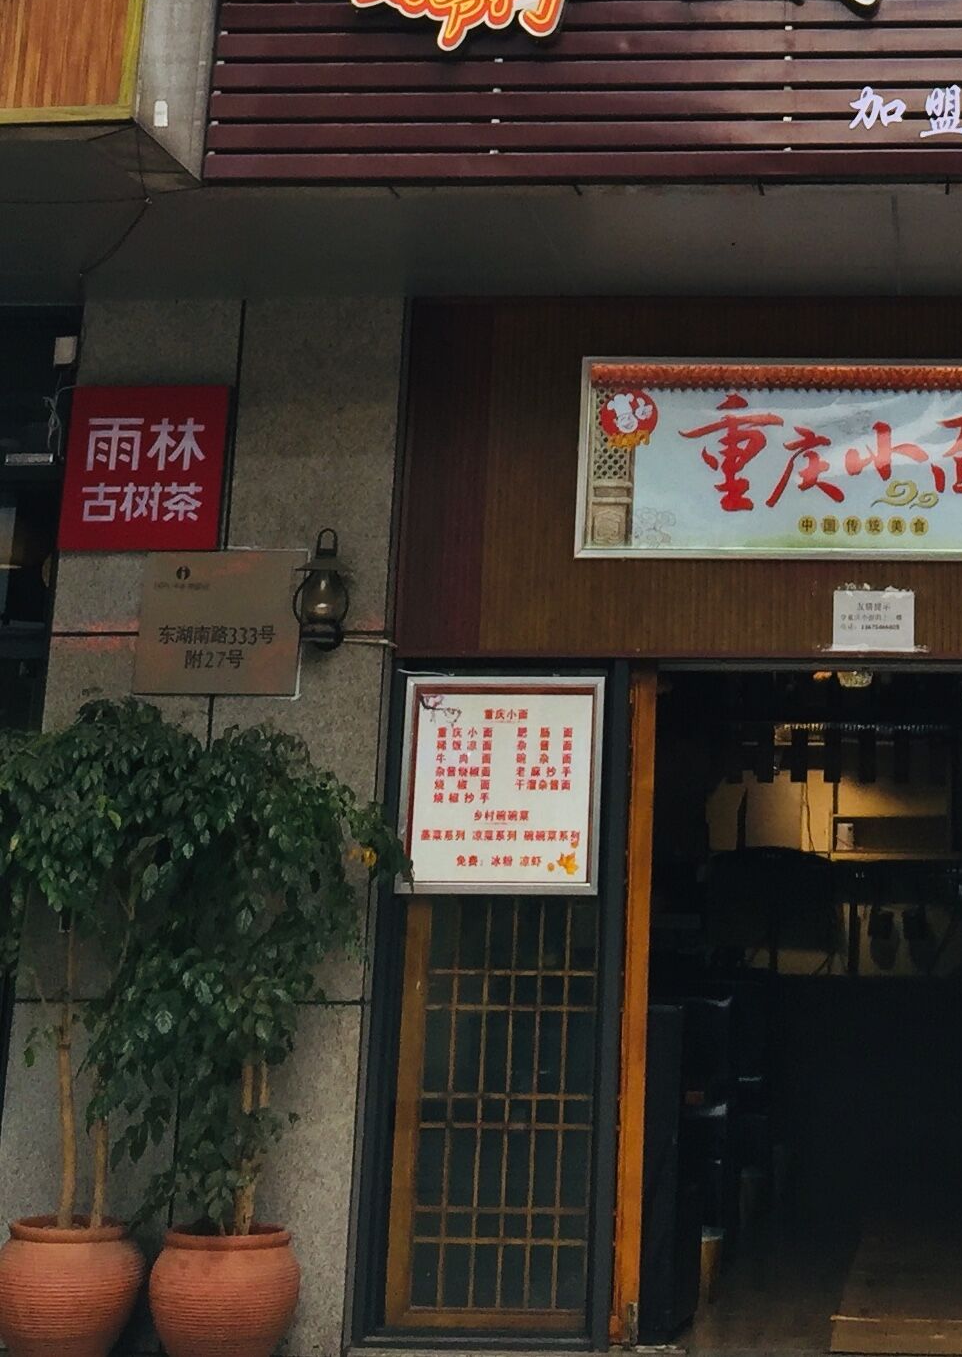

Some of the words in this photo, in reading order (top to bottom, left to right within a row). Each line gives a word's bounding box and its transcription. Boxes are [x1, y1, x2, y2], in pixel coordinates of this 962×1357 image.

[86, 417, 206, 472] 雨林
[82, 482, 203, 523] 古树茶
[799, 515, 929, 536] 中国传统美食
[159, 625, 276, 646] 东湖南路333号
[184, 650, 244, 669] 附27号
